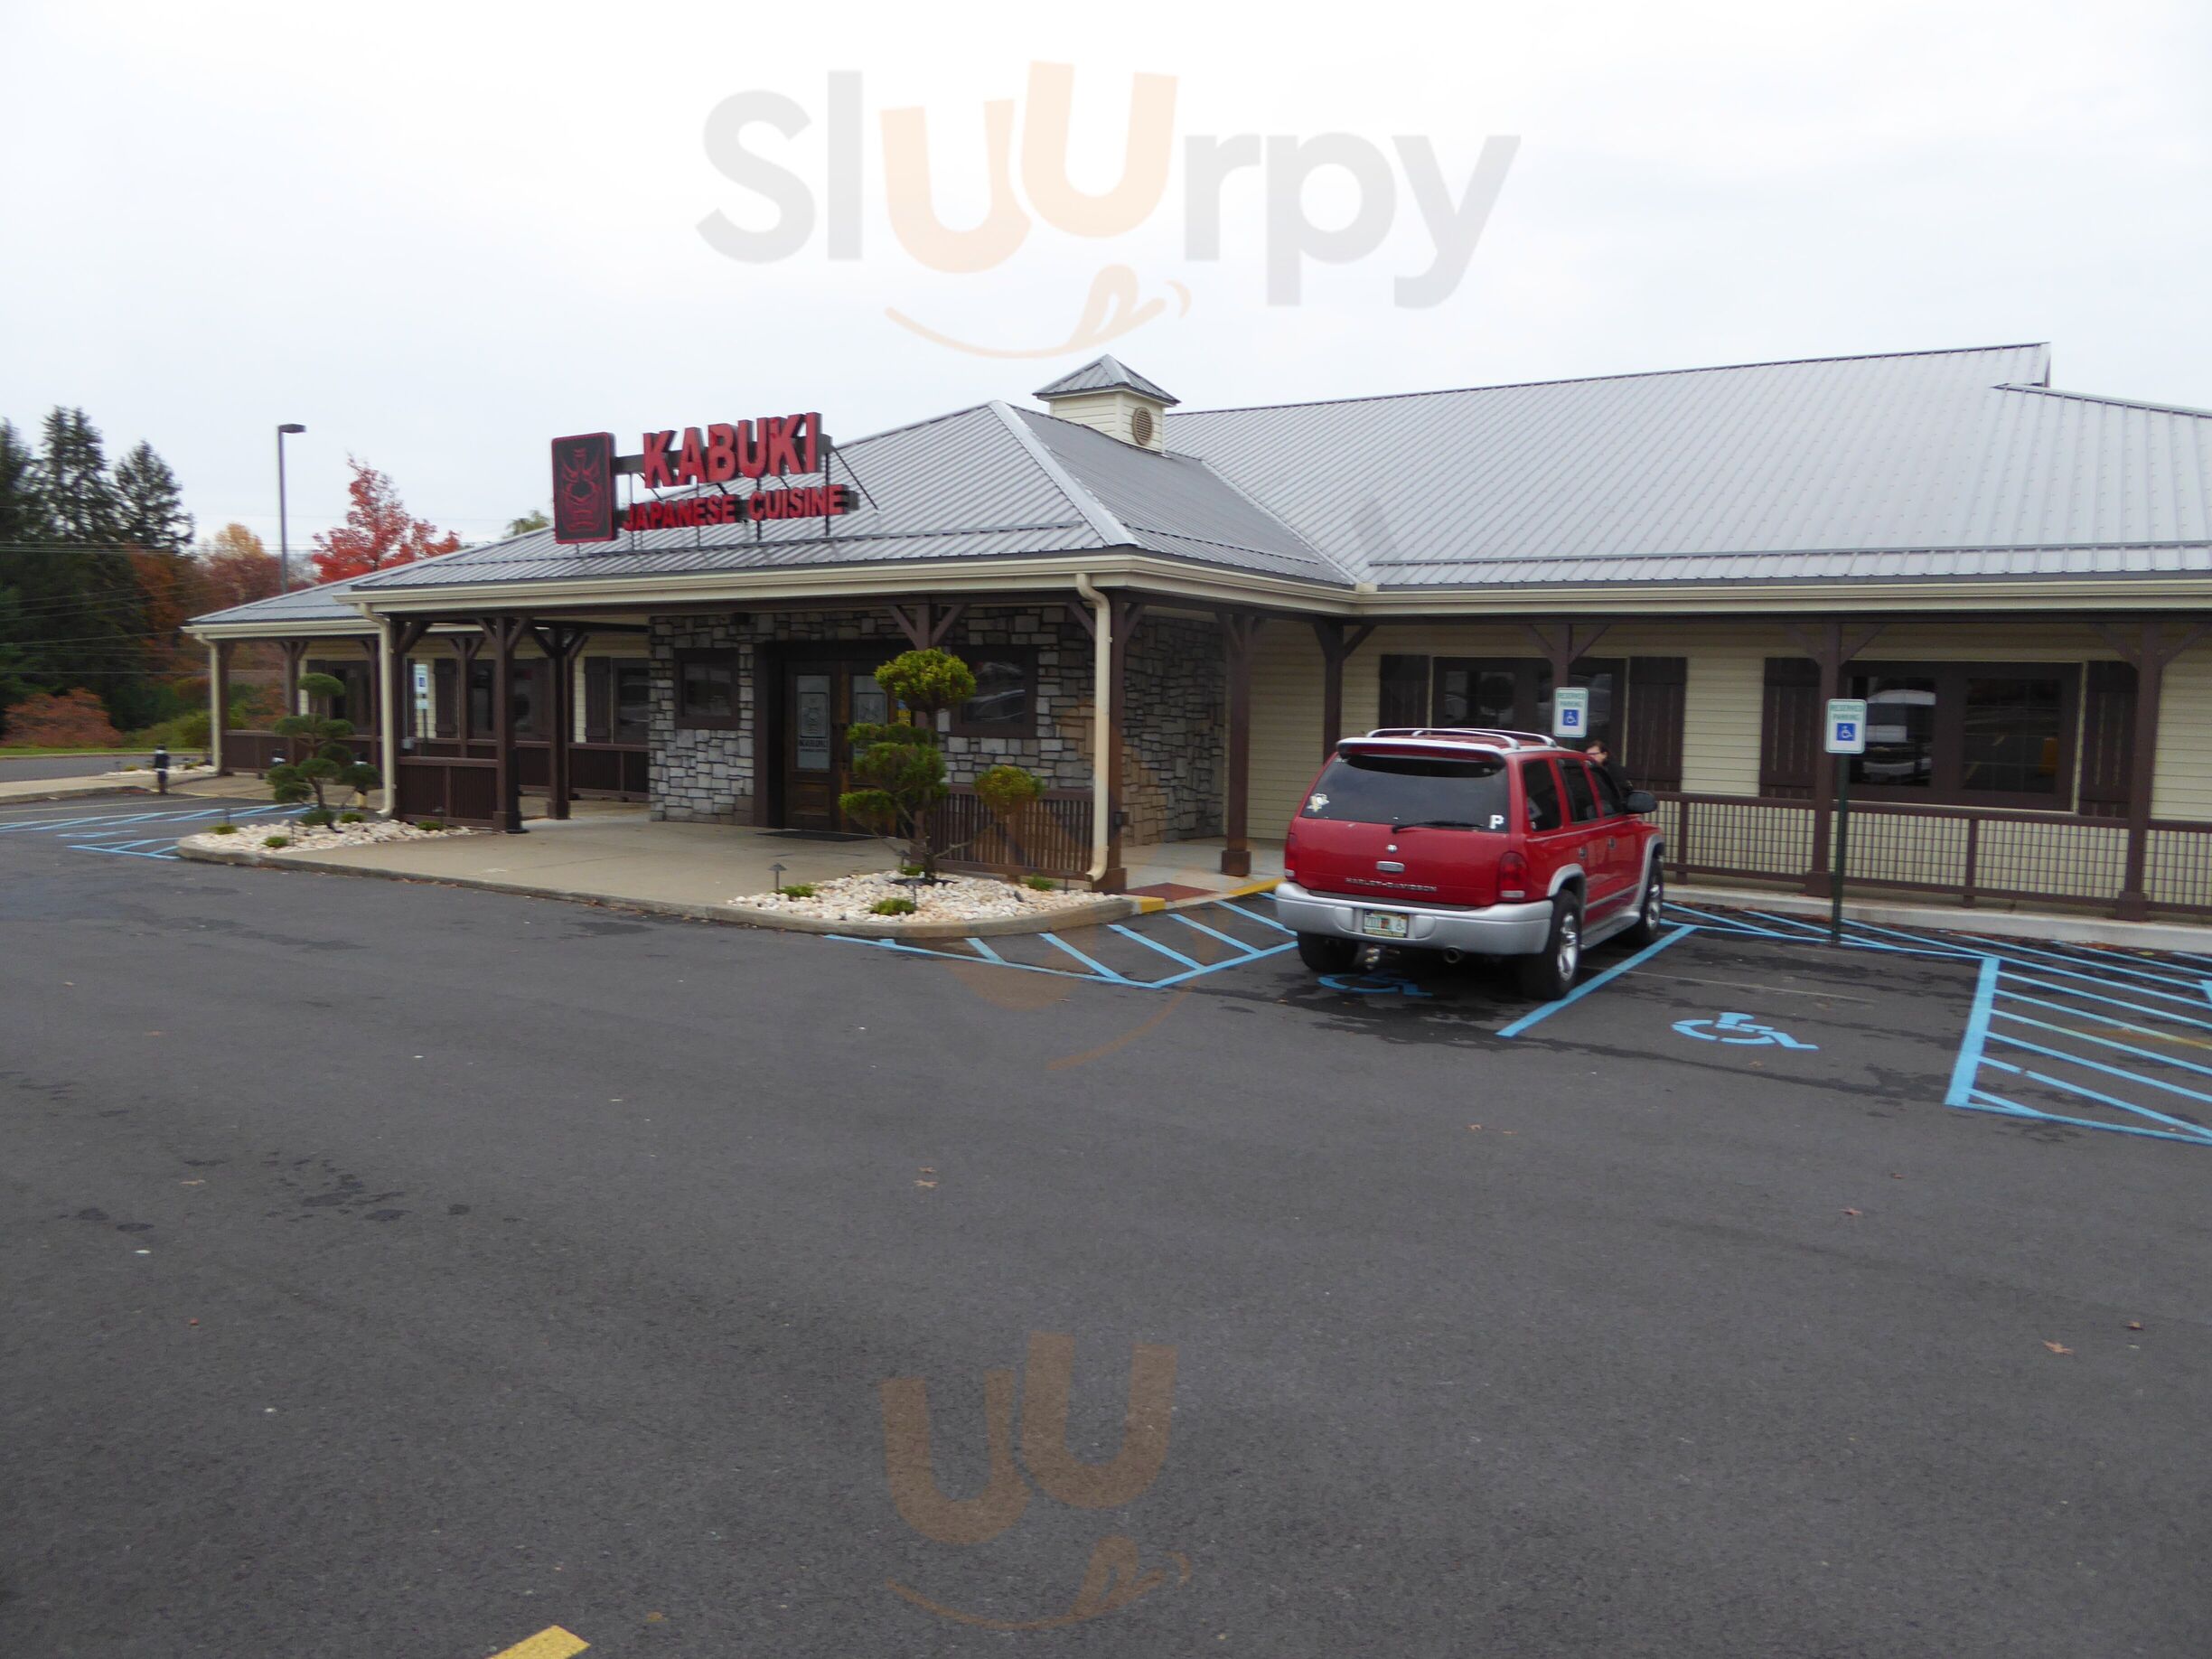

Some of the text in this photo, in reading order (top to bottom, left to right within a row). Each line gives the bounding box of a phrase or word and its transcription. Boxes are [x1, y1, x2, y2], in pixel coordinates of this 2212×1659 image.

[642, 411, 821, 489] KABUKI
[622, 484, 847, 532] JAPANESE CUISINE
